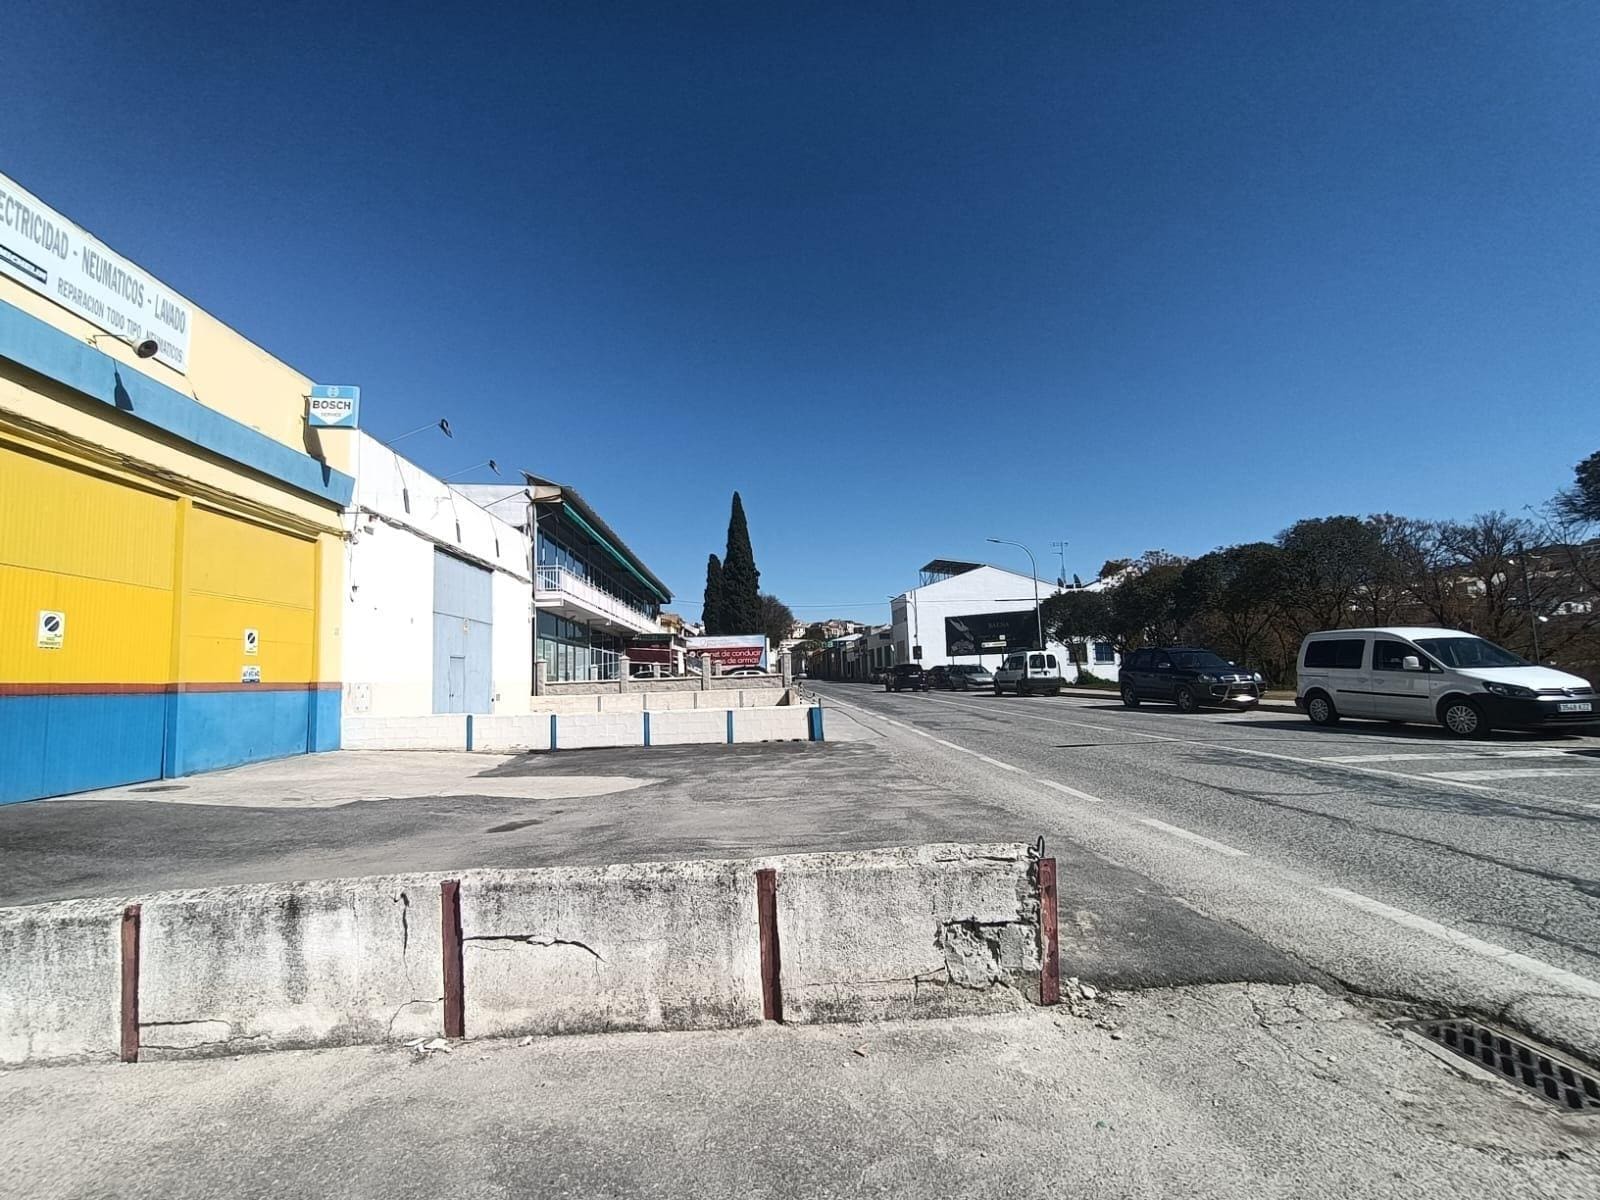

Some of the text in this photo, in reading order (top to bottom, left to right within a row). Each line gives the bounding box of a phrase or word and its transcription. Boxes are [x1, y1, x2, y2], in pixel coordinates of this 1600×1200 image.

[58, 278, 183, 363] REPARACION TODO TIPO NMATICOS
[82, 246, 144, 308] NEUMATICOS
[155, 294, 186, 334] LAVADO
[312, 400, 351, 410] BOSCH
